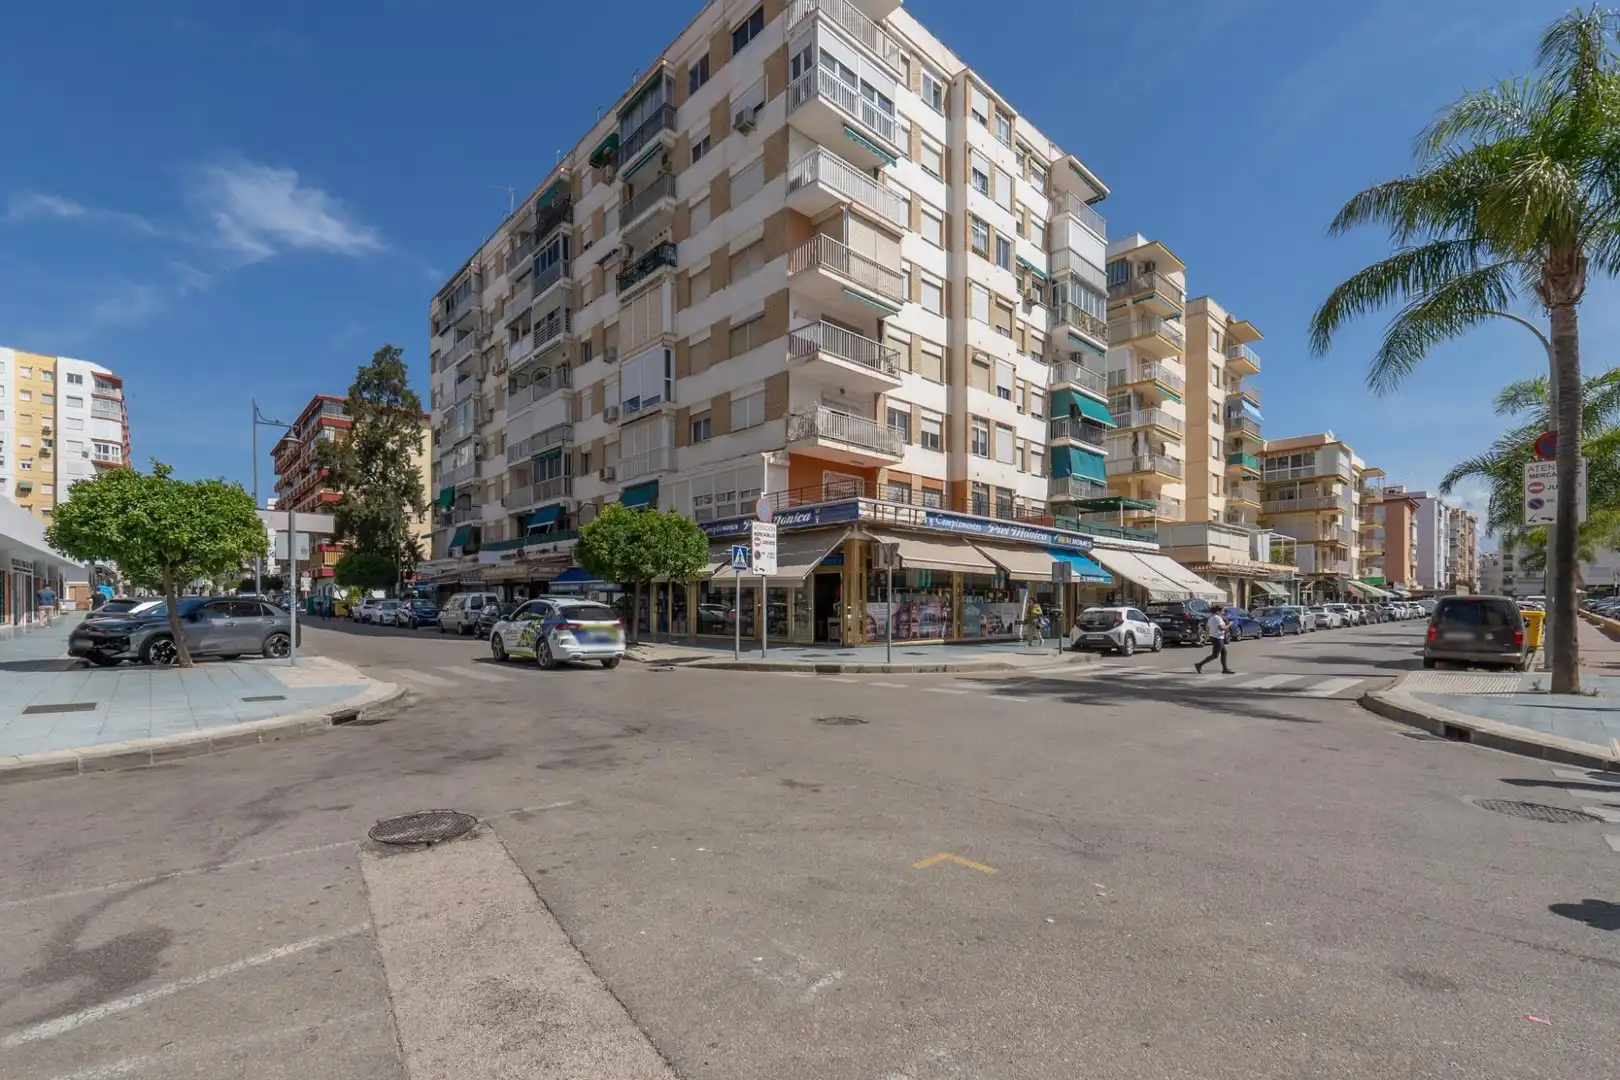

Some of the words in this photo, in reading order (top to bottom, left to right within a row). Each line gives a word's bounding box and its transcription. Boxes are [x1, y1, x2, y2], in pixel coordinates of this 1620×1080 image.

[936, 514, 982, 532] Complementos
[988, 523, 1010, 536] Piel
[1011, 525, 1048, 541] Mónica
